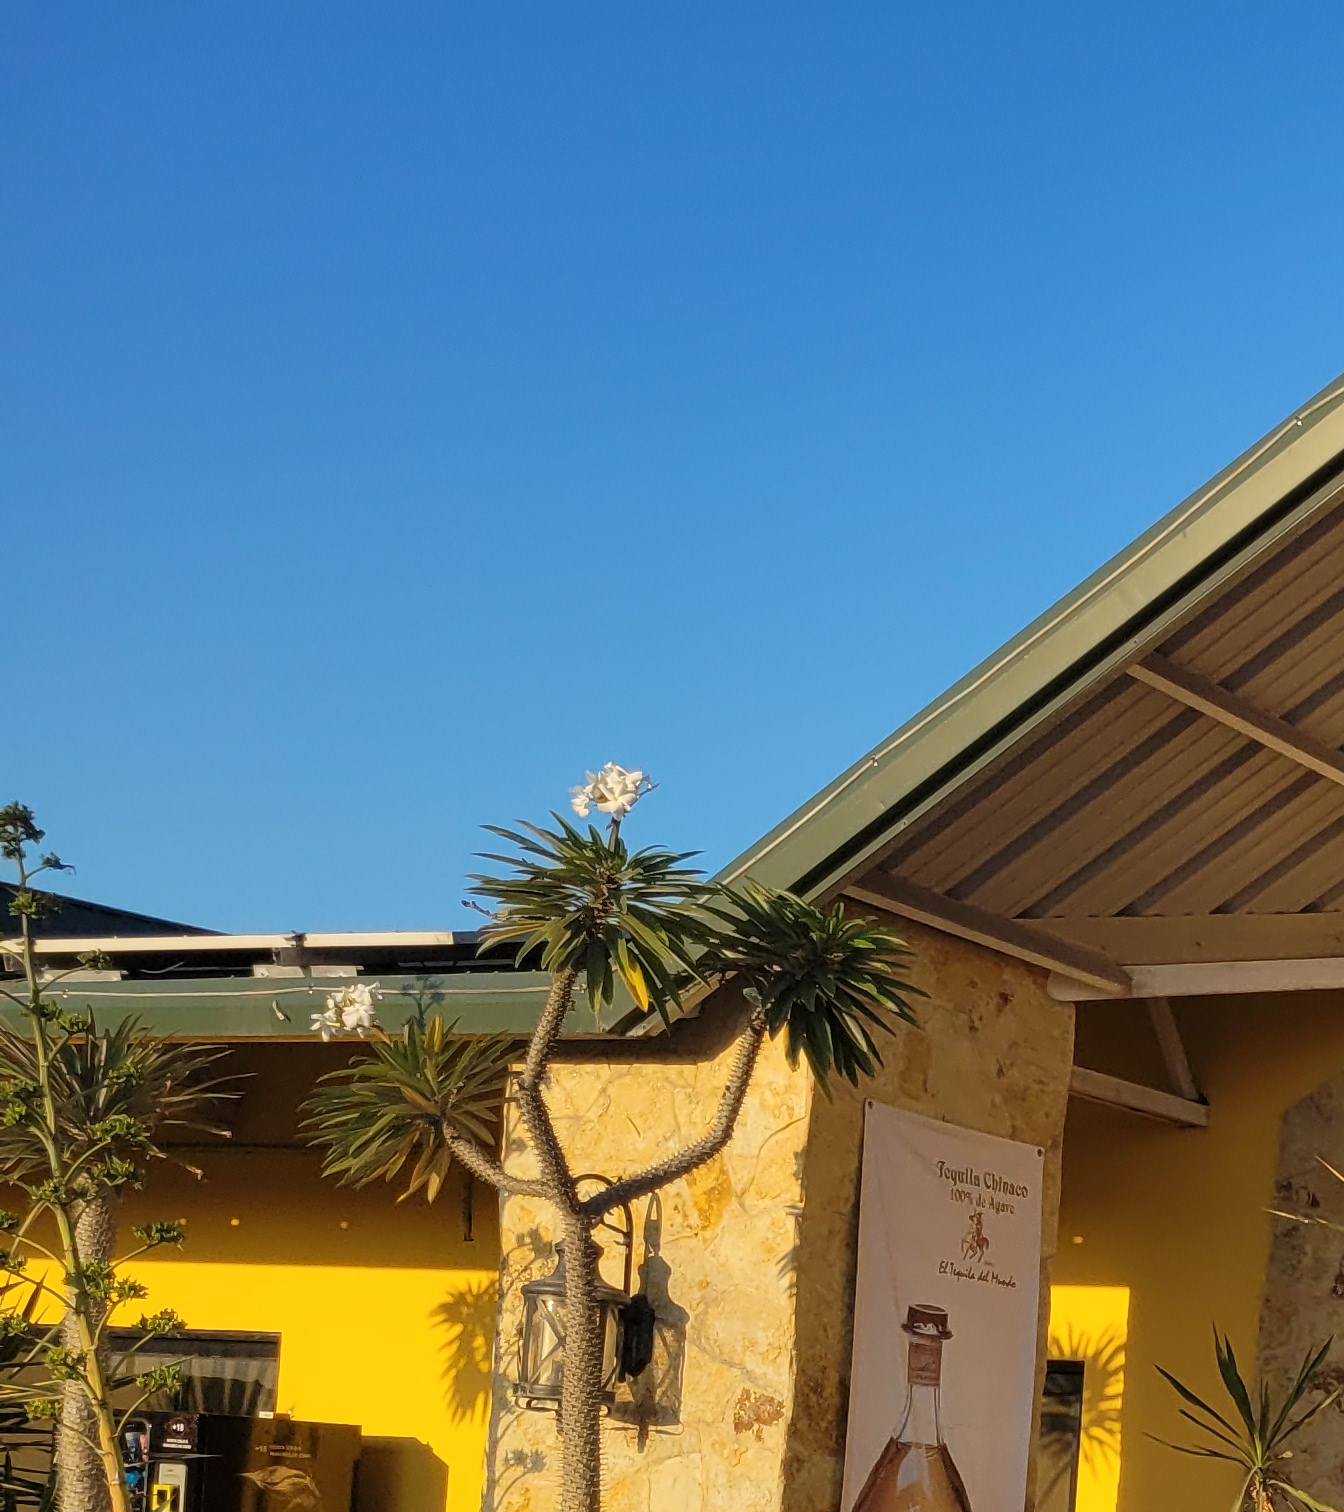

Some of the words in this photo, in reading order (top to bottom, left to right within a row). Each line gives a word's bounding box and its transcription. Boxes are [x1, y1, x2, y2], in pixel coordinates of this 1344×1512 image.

[936, 1160, 981, 1187] Tequila
[983, 1172, 1029, 1199] Chinaco
[976, 1193, 986, 1209] de
[988, 1196, 1015, 1215] Agave
